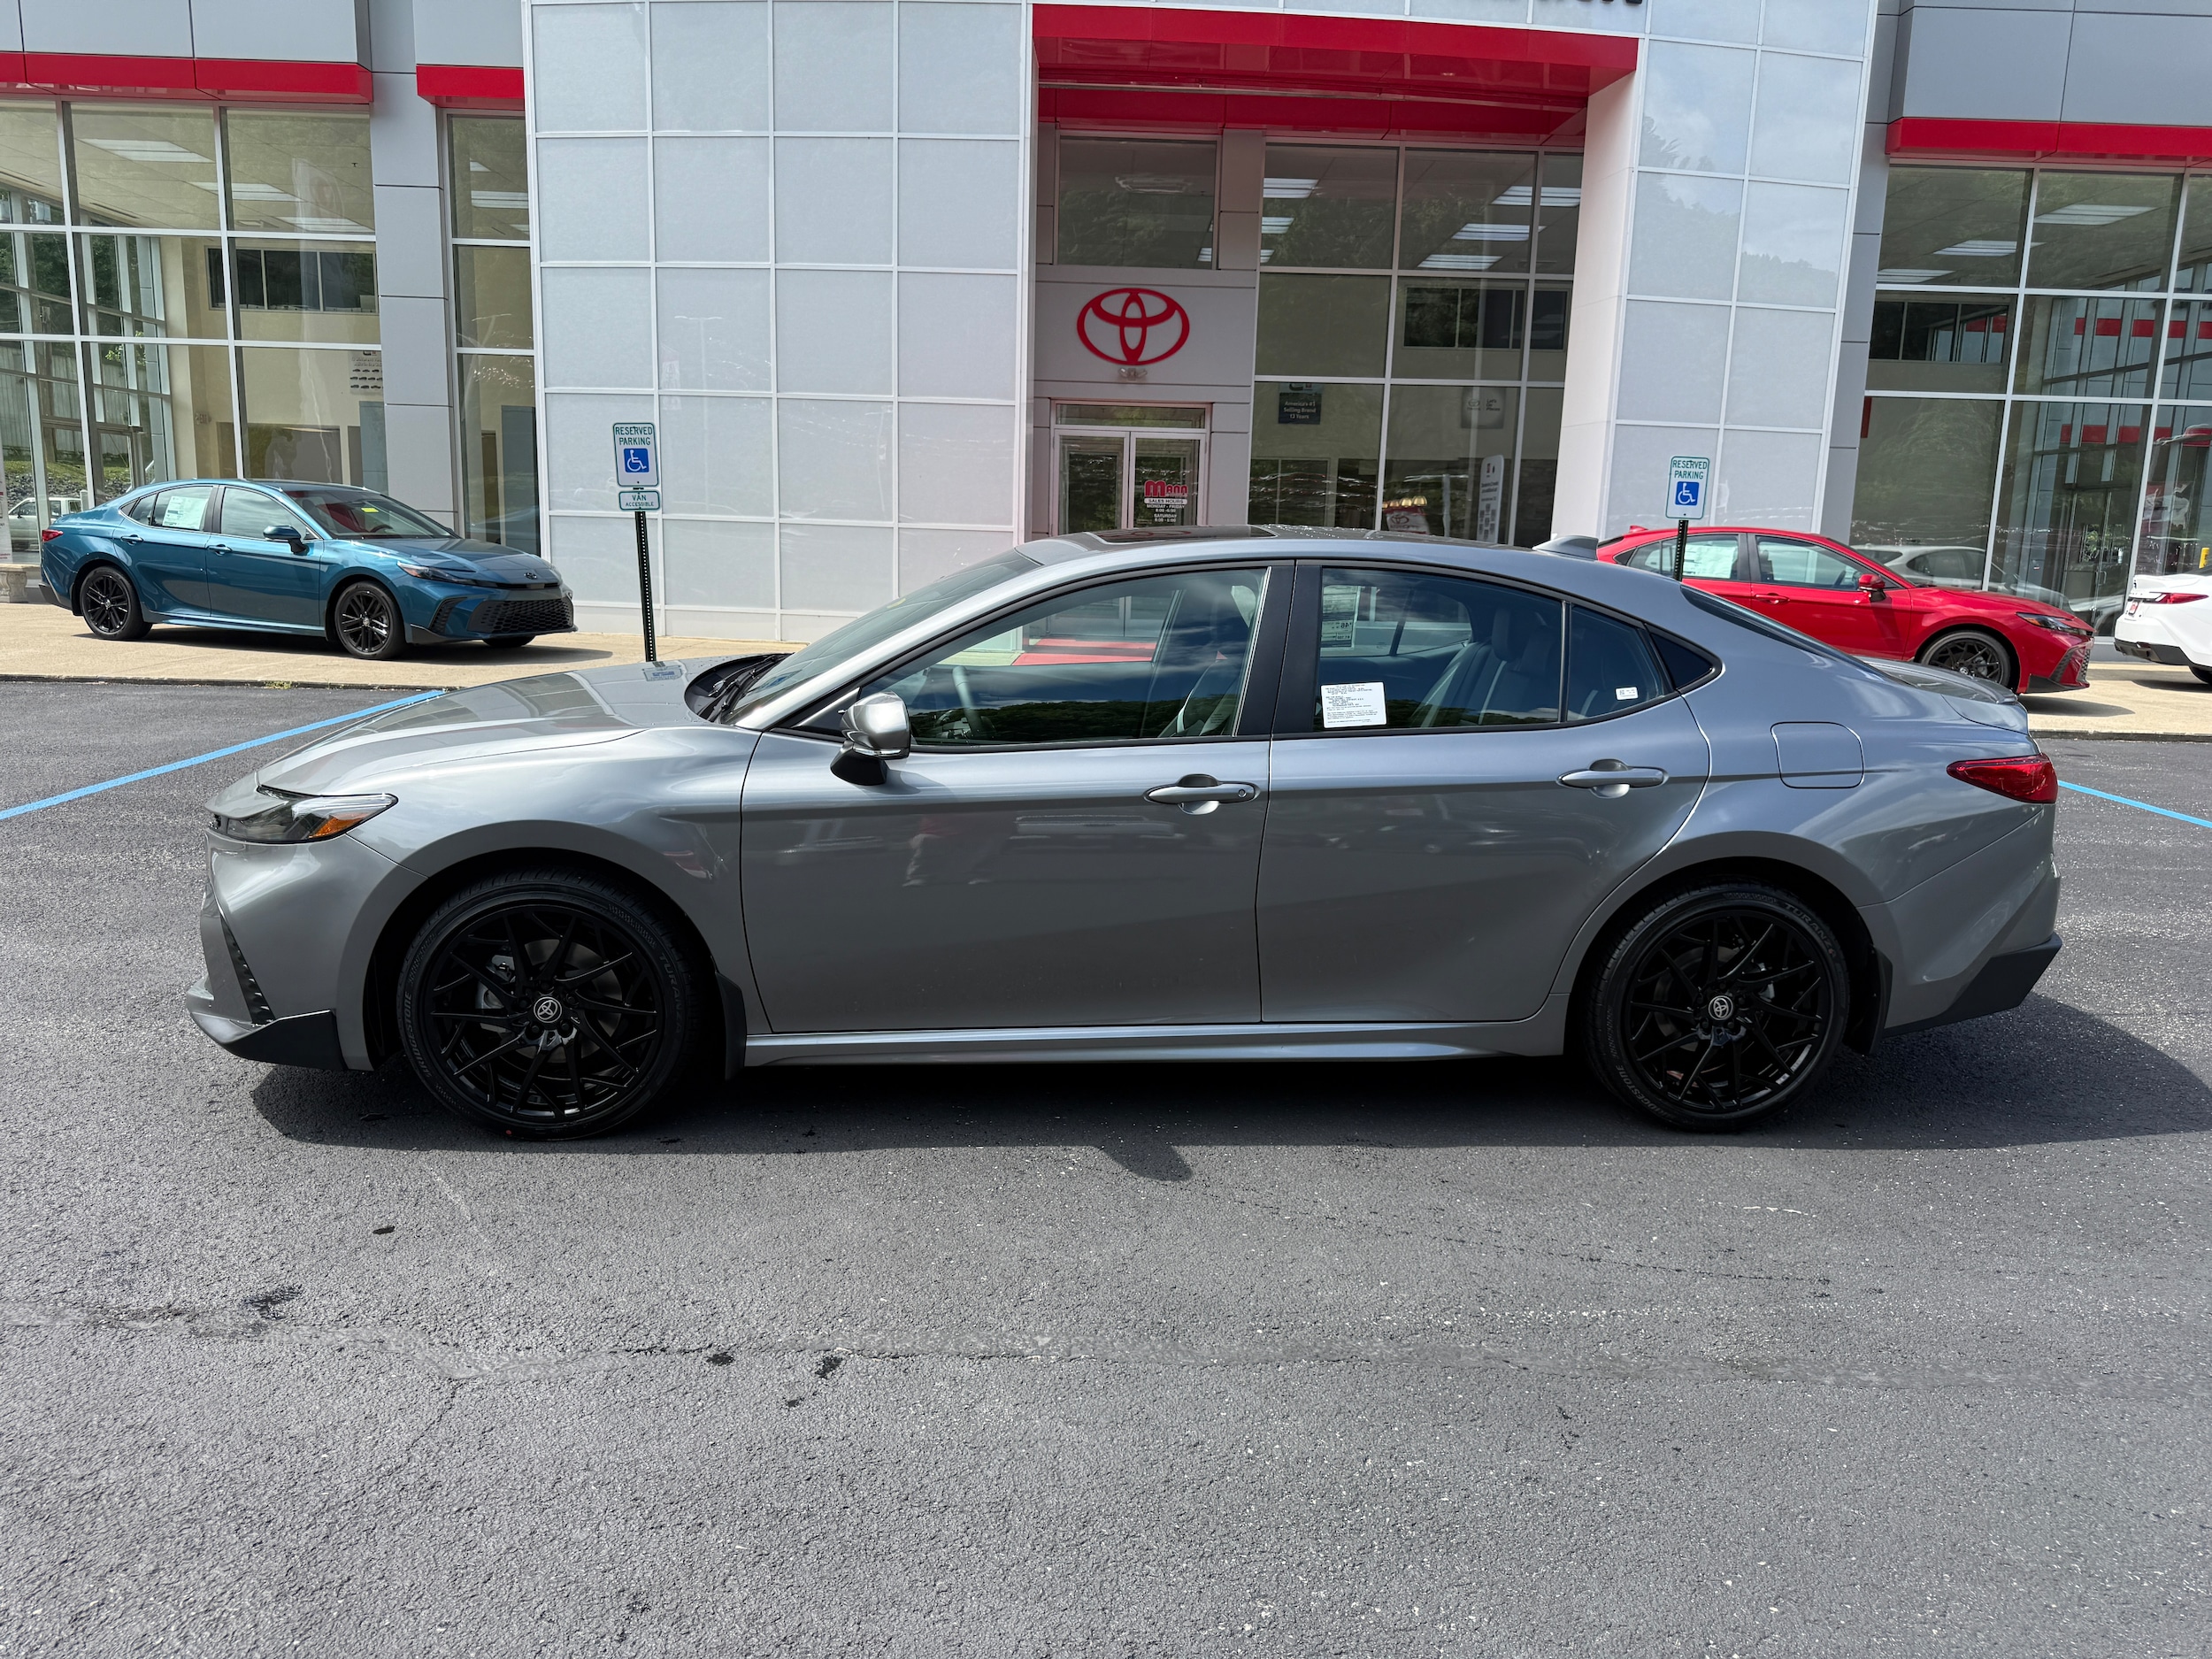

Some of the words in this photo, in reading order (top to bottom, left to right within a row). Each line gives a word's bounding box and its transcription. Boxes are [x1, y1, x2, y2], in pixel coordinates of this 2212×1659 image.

[615, 426, 653, 435] RESERVED
[618, 437, 651, 446] PARKING
[1672, 460, 1708, 470] RESERVED
[1674, 470, 1704, 480] PARKING
[1784, 902, 1838, 958] TURANZA
[658, 952, 682, 1034] TURANZA
[403, 990, 433, 1079] BRIDGESTONE
